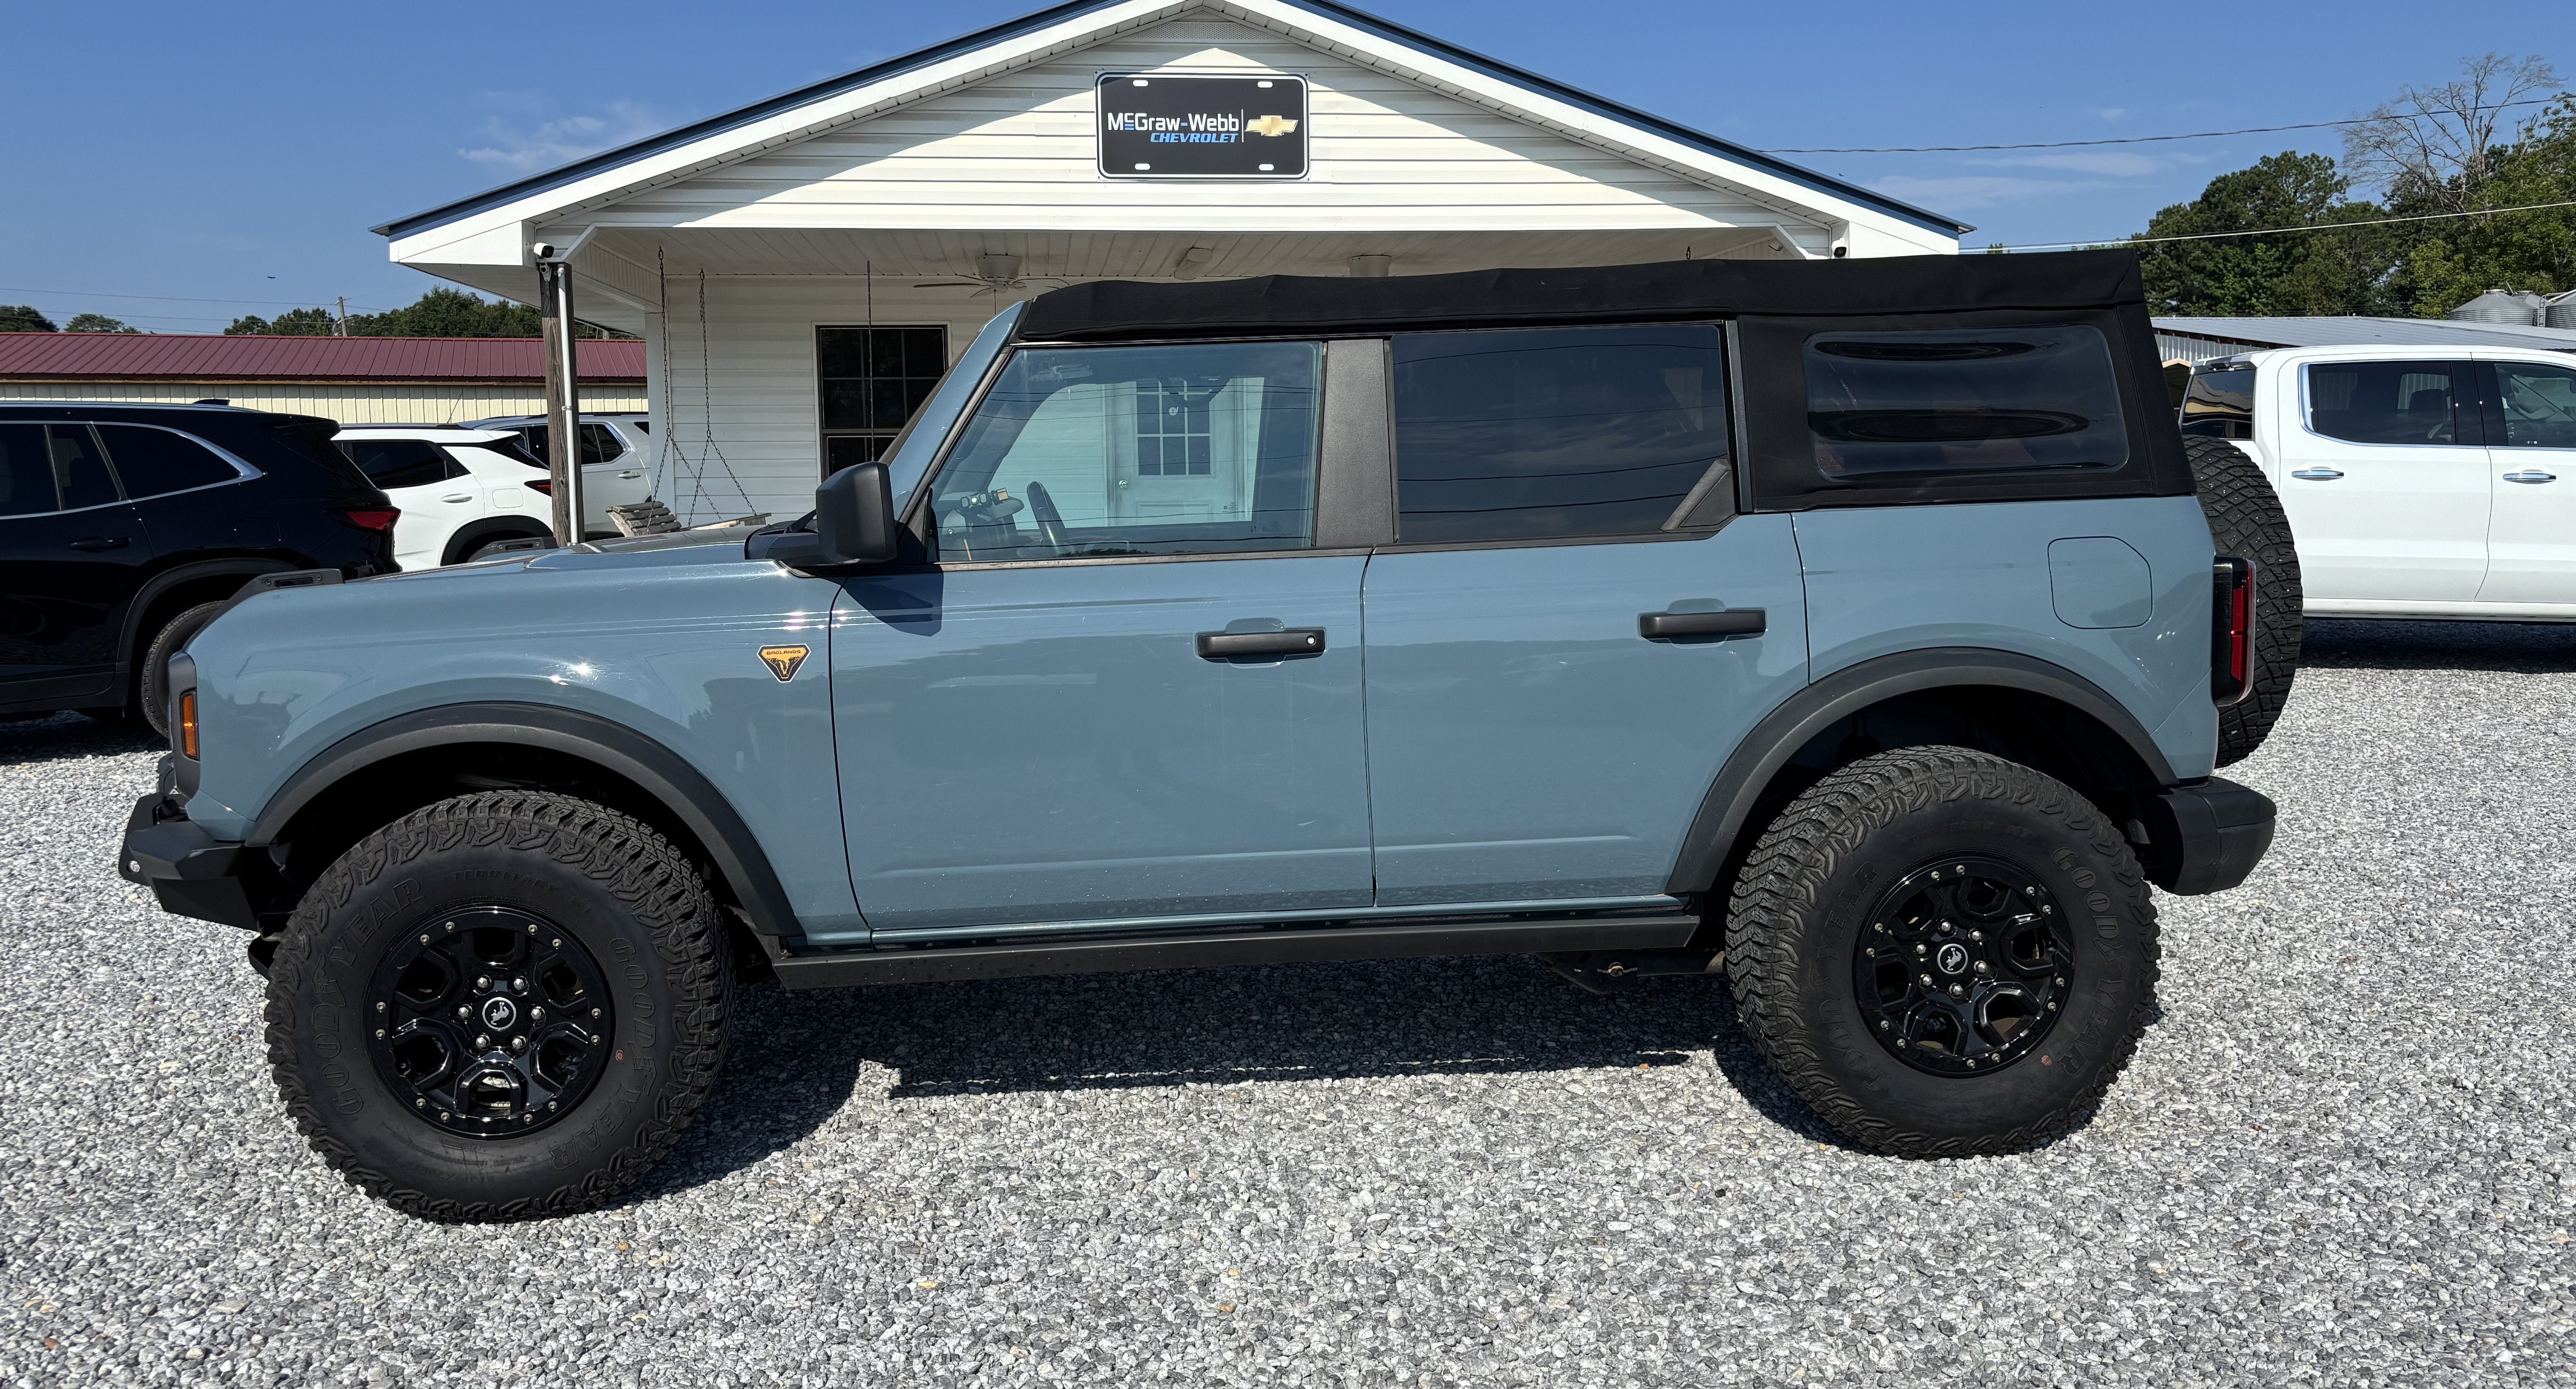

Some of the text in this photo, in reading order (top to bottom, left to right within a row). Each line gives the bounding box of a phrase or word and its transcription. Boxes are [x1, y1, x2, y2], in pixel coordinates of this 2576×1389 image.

[1108, 112, 1239, 132] McGraw-Webb
[1150, 133, 1239, 143] CHEVROLET
[312, 878, 425, 1115] GOODYEAR
